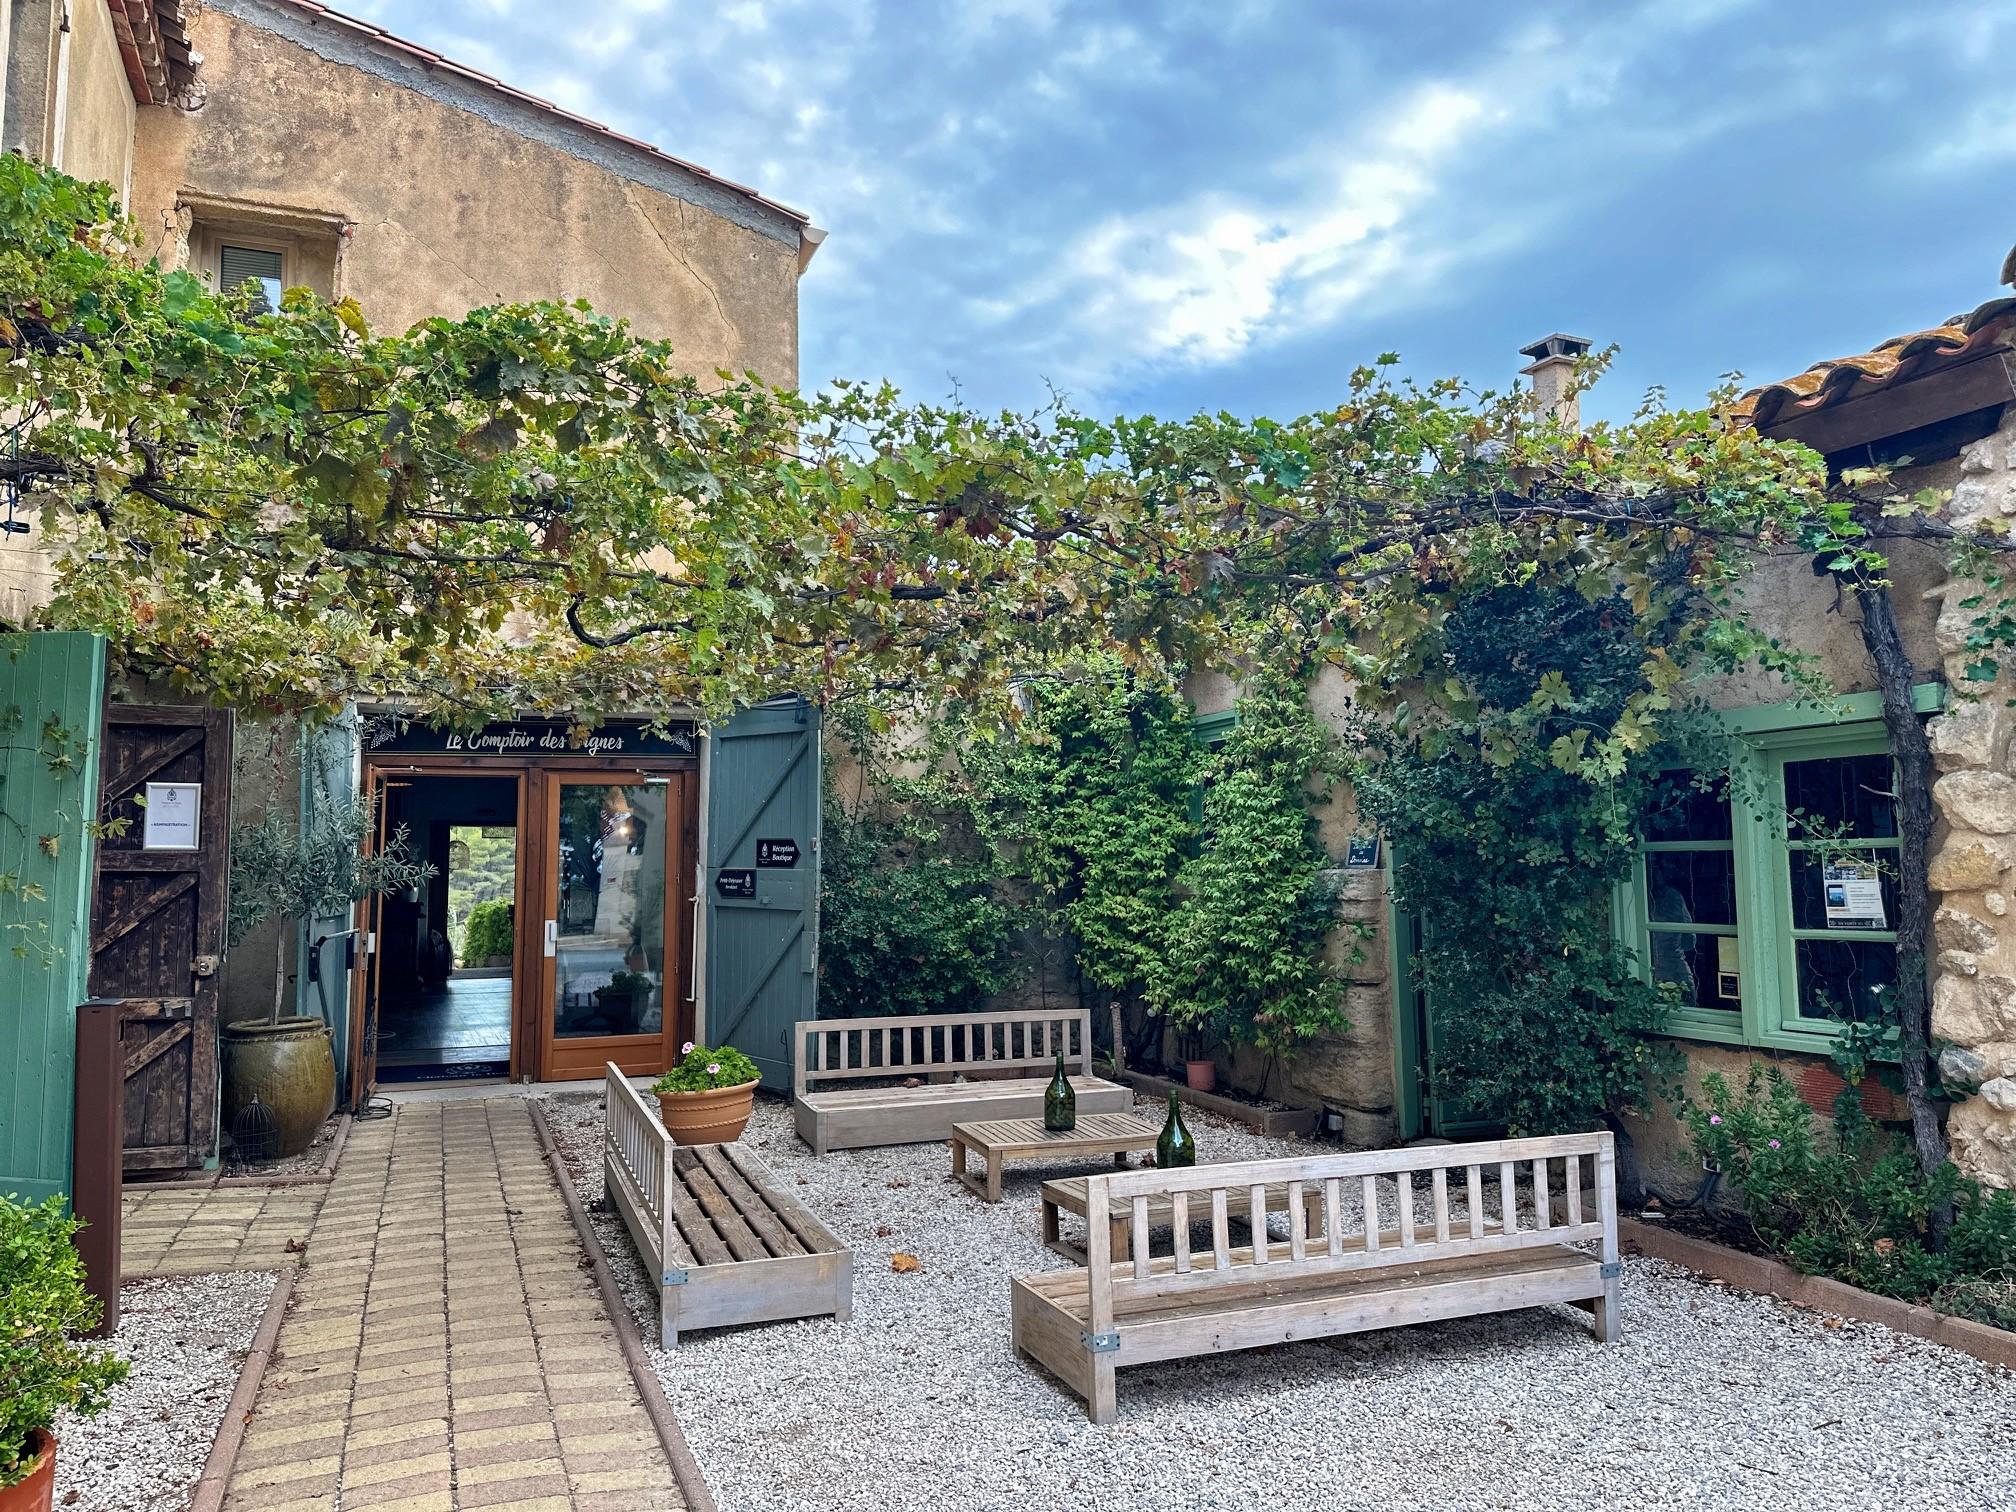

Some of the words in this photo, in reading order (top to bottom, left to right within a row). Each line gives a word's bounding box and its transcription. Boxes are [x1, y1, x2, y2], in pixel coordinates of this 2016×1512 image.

[446, 734, 464, 749] Le
[467, 728, 535, 754] Comptoir
[540, 728, 567, 749] des
[581, 736, 624, 756] ignes
[772, 844, 795, 854] Réception
[772, 854, 793, 862] Boutique
